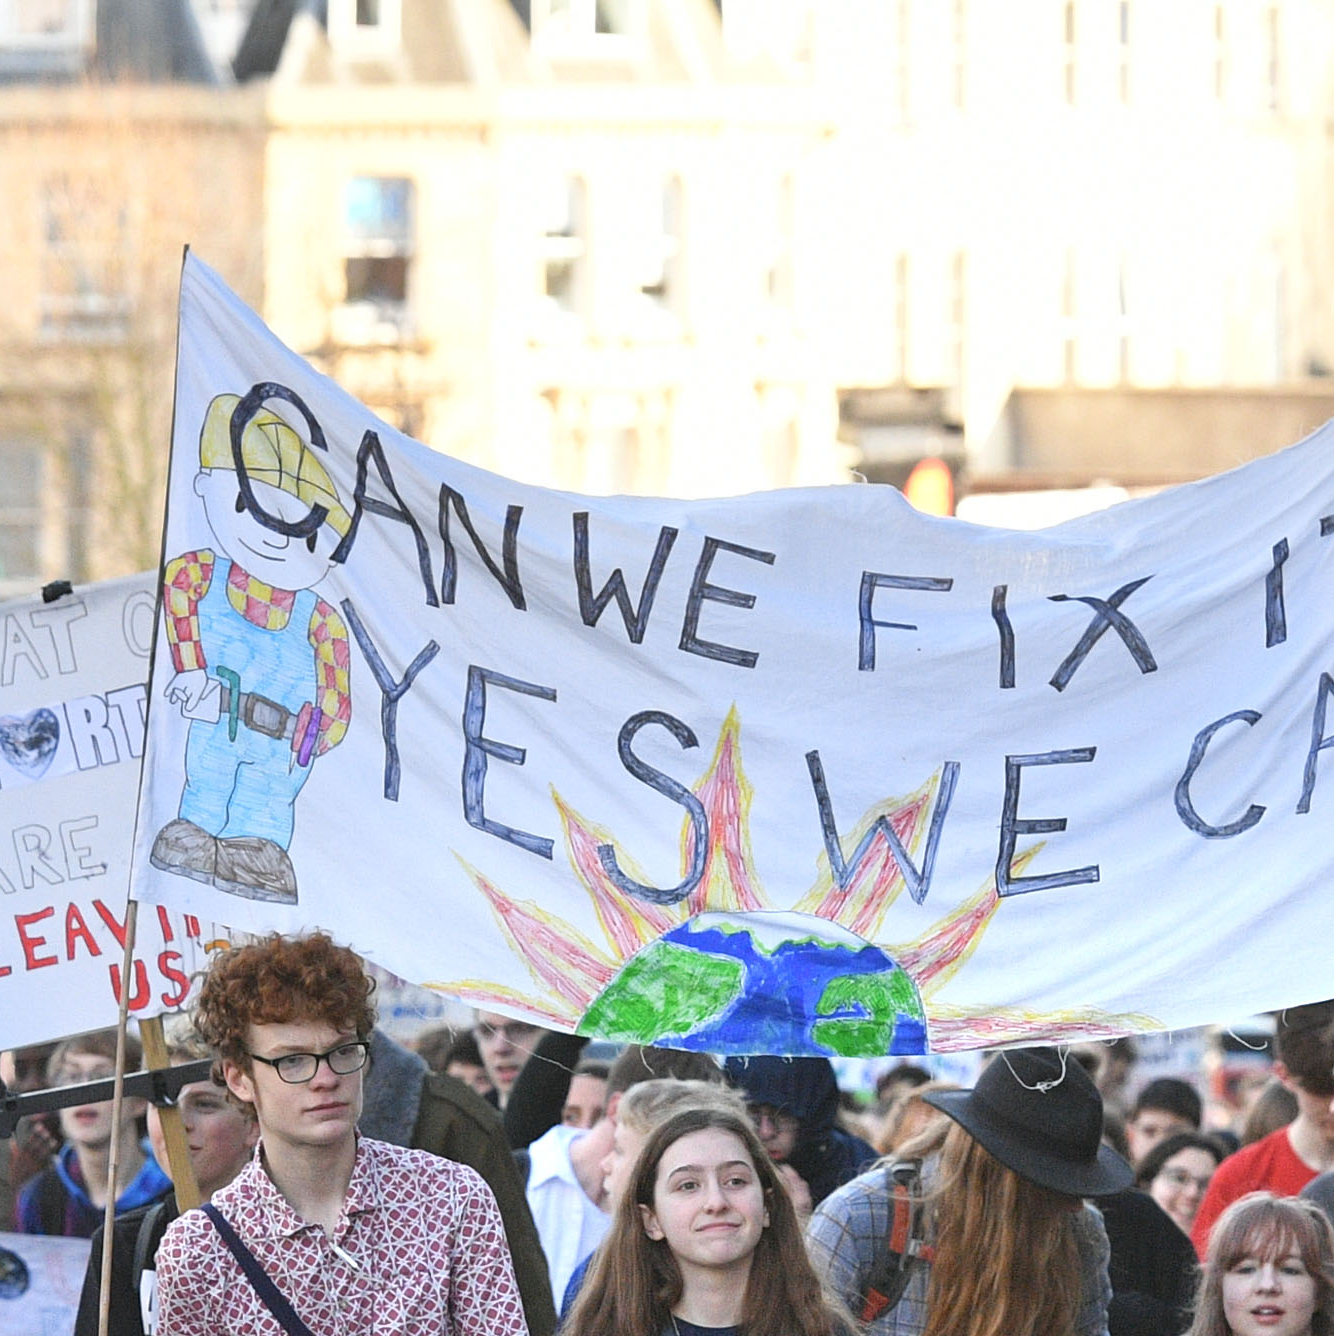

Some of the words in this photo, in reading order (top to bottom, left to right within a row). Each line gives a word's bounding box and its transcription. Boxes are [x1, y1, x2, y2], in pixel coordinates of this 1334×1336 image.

[229, 381, 526, 612] CAN
[572, 511, 776, 669] WE
[858, 572, 1157, 692] FIX
[340, 596, 711, 906] YES
[806, 746, 1100, 905] WE
[109, 950, 191, 1012] US
